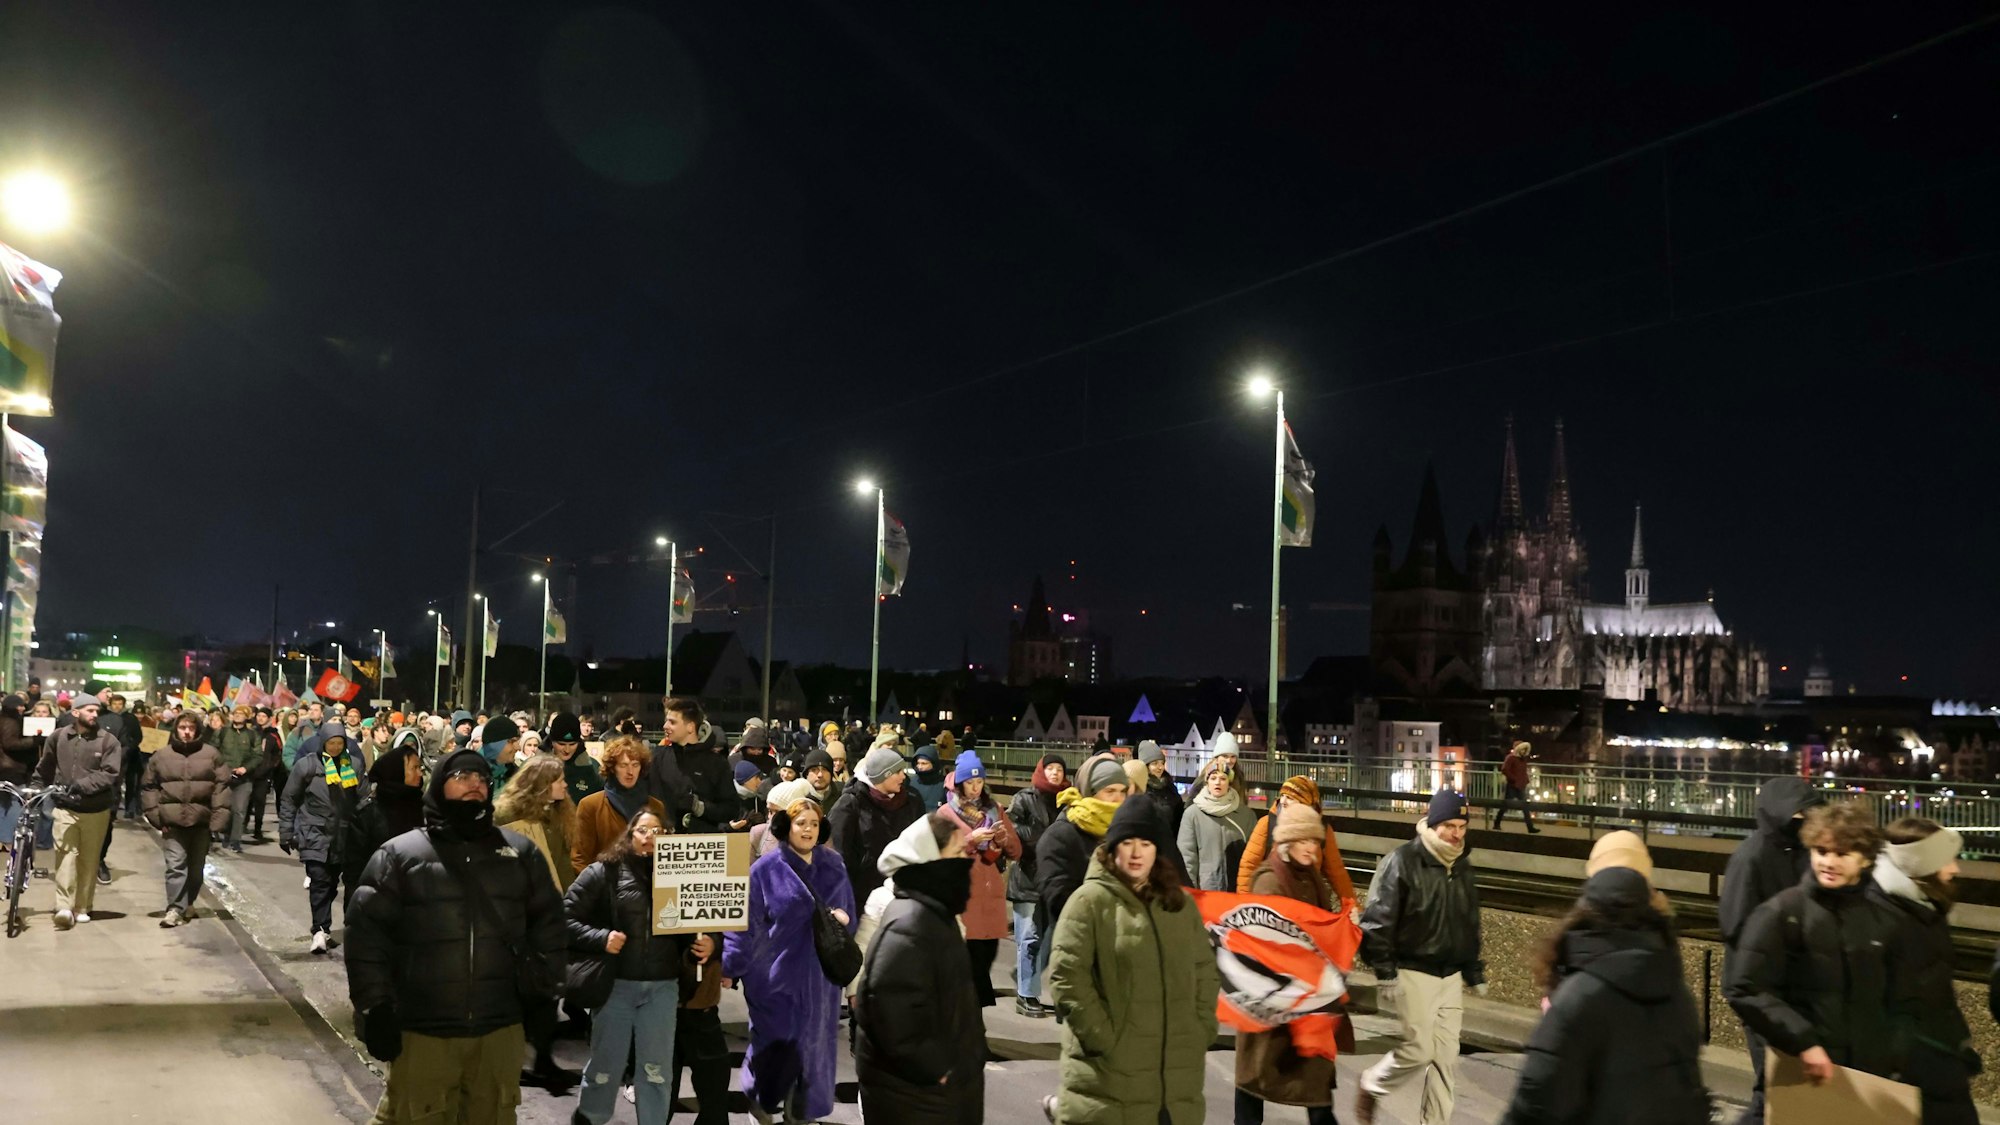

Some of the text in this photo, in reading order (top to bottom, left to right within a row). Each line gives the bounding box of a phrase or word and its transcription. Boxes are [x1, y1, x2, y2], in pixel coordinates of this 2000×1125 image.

[657, 841, 725, 850] ICH HABE
[657, 850, 725, 862] HEUTE
[680, 883, 746, 892] KEINEN
[680, 907, 744, 920] LAND
